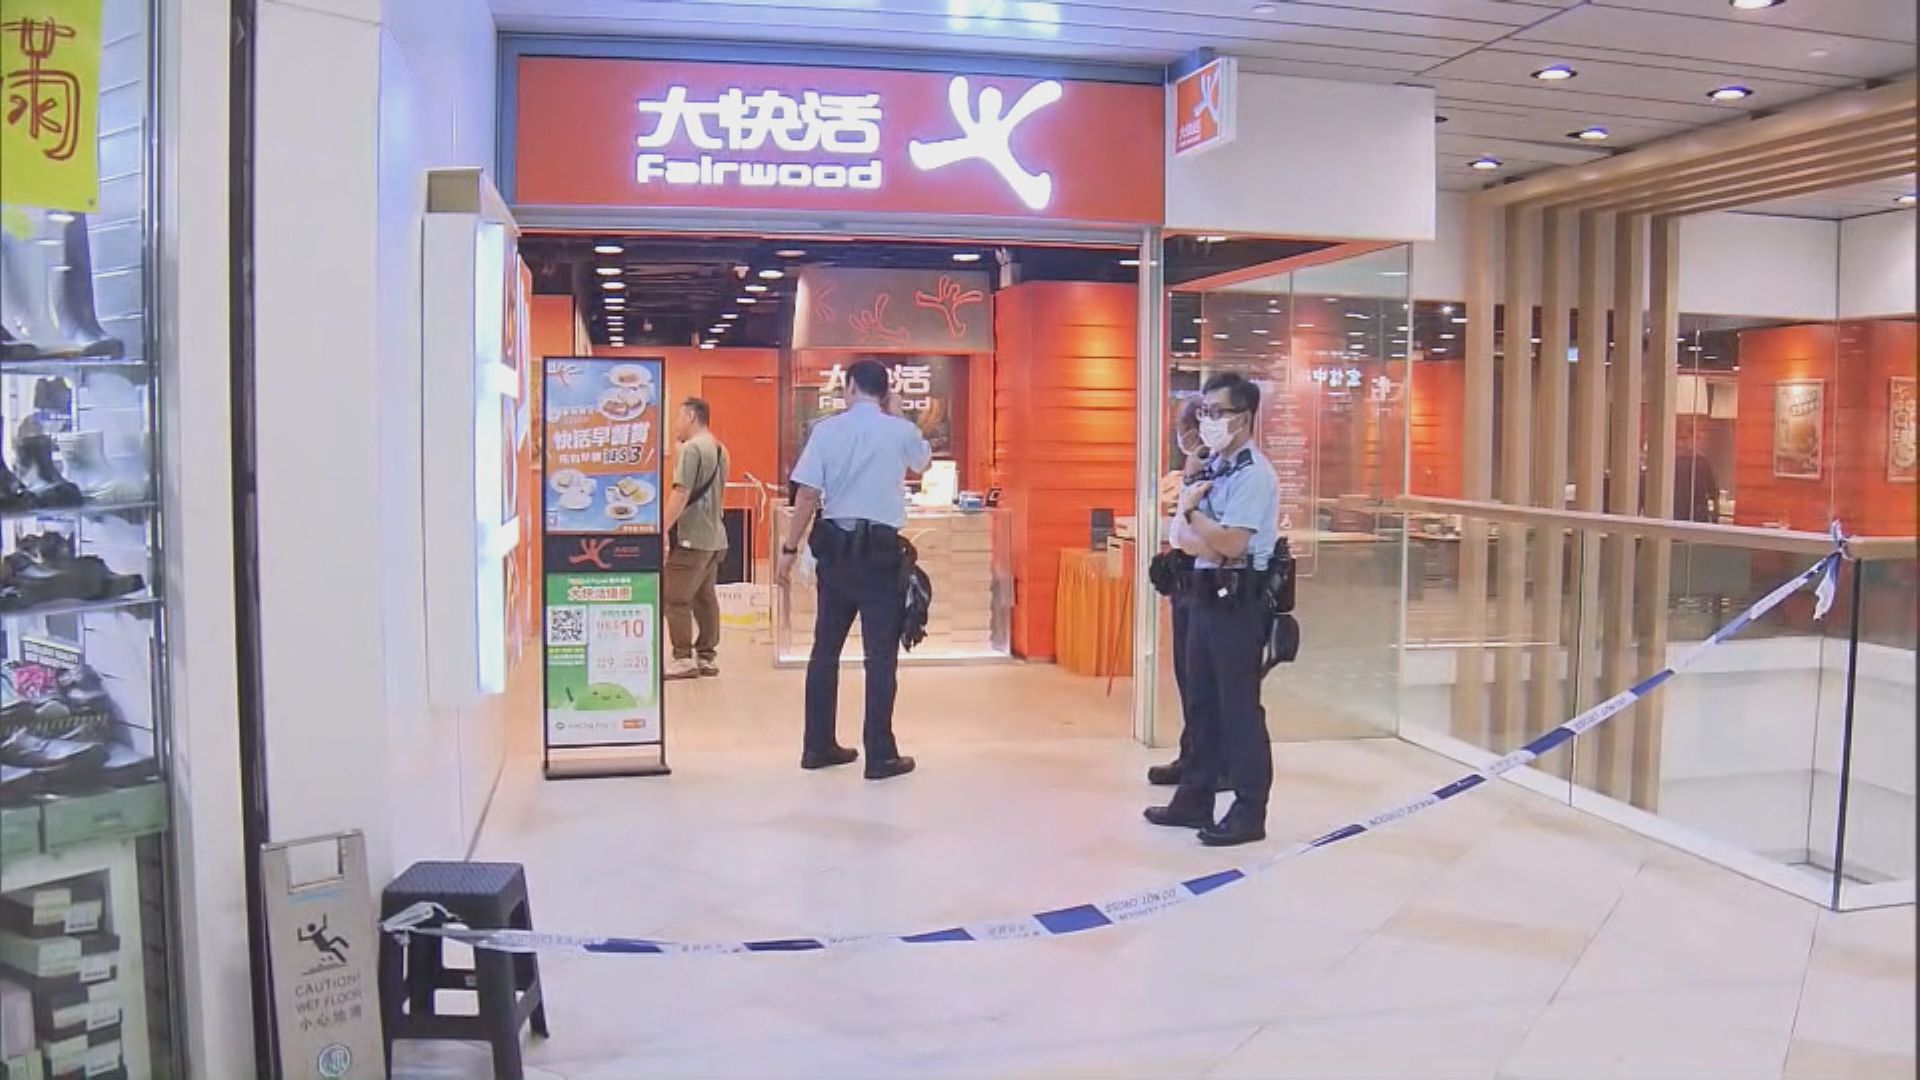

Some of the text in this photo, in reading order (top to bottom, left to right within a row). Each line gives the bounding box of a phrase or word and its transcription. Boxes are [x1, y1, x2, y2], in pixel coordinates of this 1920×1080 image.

[637, 86, 882, 153] 大快活
[637, 154, 882, 189] Fairwood
[819, 364, 932, 394] 大活
[295, 968, 361, 998] CAUTION!
